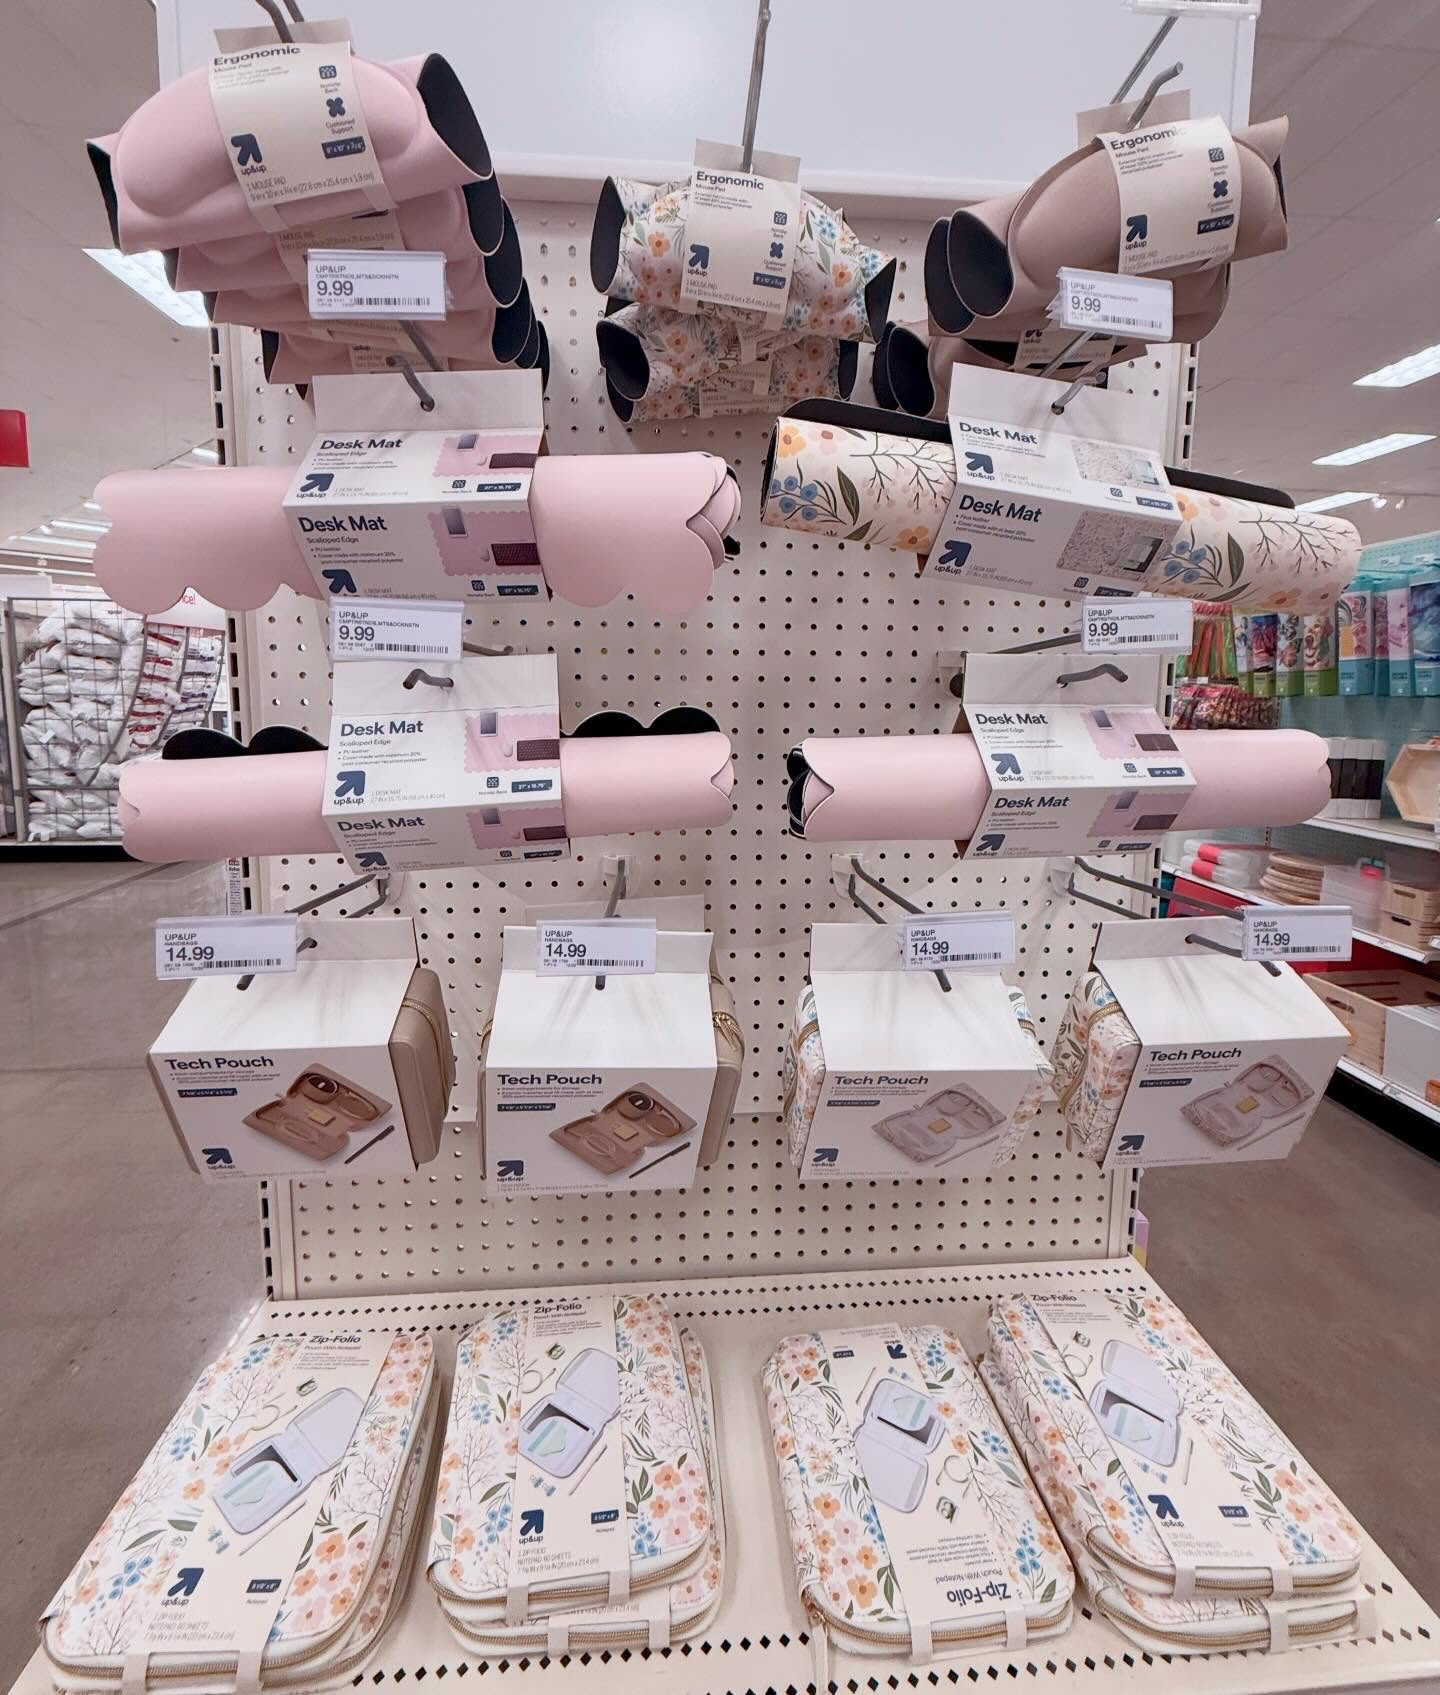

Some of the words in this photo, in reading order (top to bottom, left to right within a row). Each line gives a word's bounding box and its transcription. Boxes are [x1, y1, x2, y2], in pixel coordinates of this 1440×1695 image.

[213, 45, 301, 66] Ergonomic
[241, 165, 267, 176] up&up
[696, 170, 765, 190] Ergonomic
[1125, 241, 1147, 250] up&up
[315, 265, 346, 273] UP&UP
[688, 268, 708, 277] up&up
[317, 280, 354, 296] 9.99
[1071, 295, 1101, 313] 9.99
[959, 422, 1000, 438] Desk
[1004, 430, 1038, 444] Mat
[320, 439, 364, 450] Desk
[368, 438, 403, 448] Mat
[967, 471, 995, 481] up&up
[959, 494, 1004, 517] Desk
[1006, 502, 1042, 523] Mat
[298, 515, 348, 532] Desk
[348, 515, 388, 531] Mat
[934, 565, 962, 575] up&up
[339, 611, 368, 619] UP&UP
[1088, 609, 1112, 617] UP&UP
[339, 625, 375, 641] 9.99
[1088, 622, 1118, 637] 9.99
[975, 713, 1015, 725] Desk
[1016, 713, 1049, 725] Mat
[340, 722, 385, 736] Desk
[389, 720, 424, 734] Mat
[334, 797, 364, 806] up&up
[994, 797, 1035, 809] Desk
[1037, 796, 1070, 807] Mat
[337, 820, 385, 832] Desk
[388, 817, 425, 828] Mat
[164, 933, 197, 941] UP&UP
[545, 930, 573, 938] UP&UP
[911, 929, 936, 938] UP&UP
[1254, 932, 1290, 947] 14.99
[166, 946, 214, 962] 14.99
[546, 943, 586, 958] 14.99
[912, 941, 949, 956] 14.99
[1150, 1050, 1188, 1062] Tech
[1191, 1047, 1242, 1060] Pouch
[164, 1058, 212, 1070] Tech
[215, 1056, 274, 1069] Pouch
[497, 1074, 541, 1085] Tech
[546, 1073, 603, 1085] Pouch
[835, 1075, 874, 1085] Tech
[877, 1075, 929, 1085] Pouch
[534, 1303, 582, 1314] Zip-Folio
[309, 1335, 361, 1344] Zip-Folio
[519, 1535, 544, 1545] up&up
[935, 1574, 964, 1584] Notepad
[964, 1572, 981, 1580] With
[946, 1581, 1012, 1607] Zip-Folio
[161, 1597, 189, 1607] up&up
